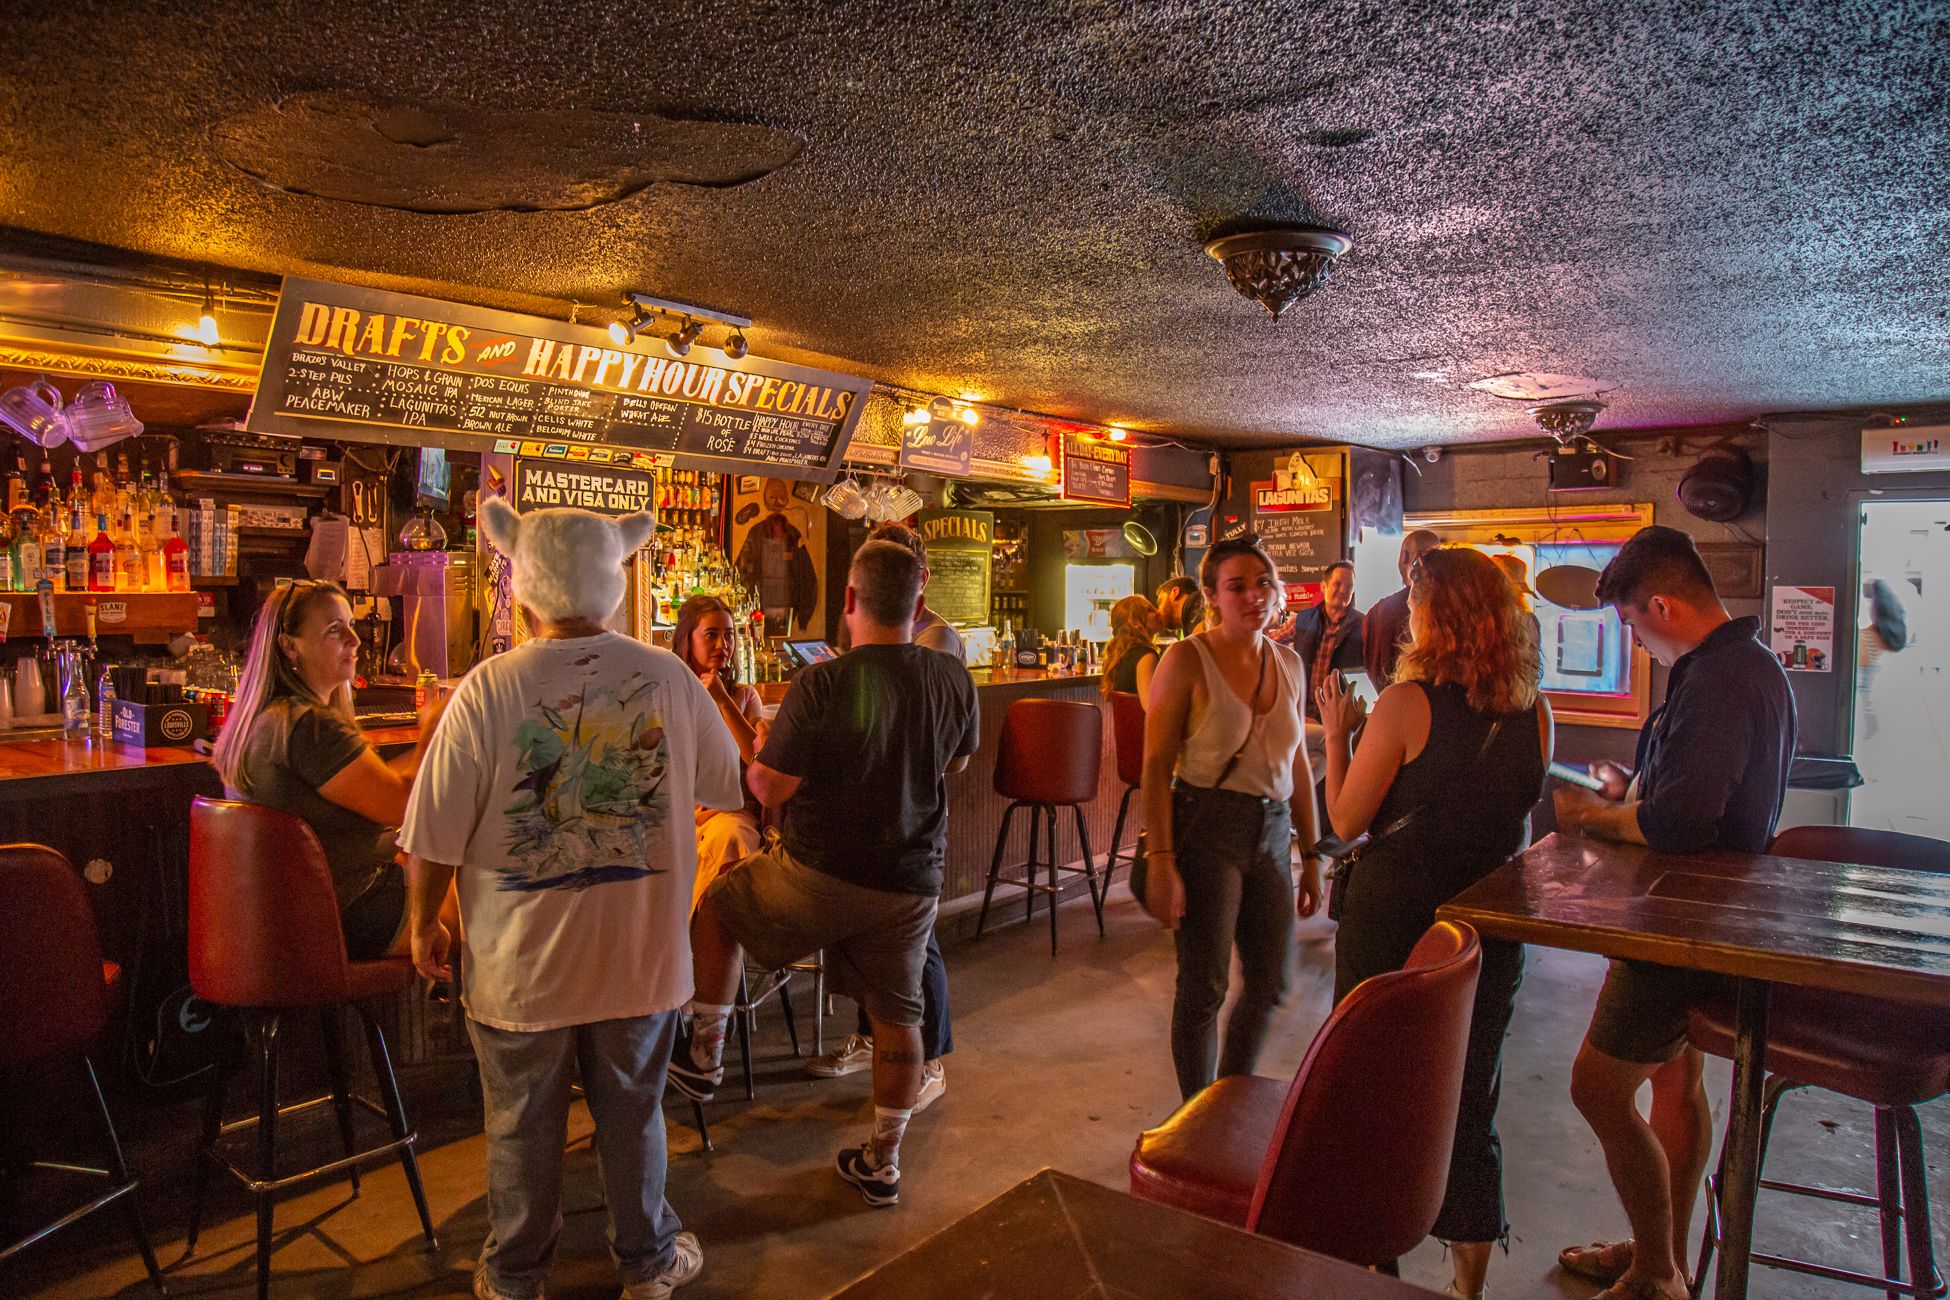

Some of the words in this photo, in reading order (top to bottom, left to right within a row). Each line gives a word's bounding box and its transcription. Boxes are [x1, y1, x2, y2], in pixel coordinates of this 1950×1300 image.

[292, 352, 327, 365] BRAZOS
[331, 358, 366, 373] VALLEY
[293, 301, 472, 366] DRAFTS
[476, 341, 517, 362] AND
[522, 337, 645, 390] HAPPY
[637, 356, 727, 407] HOUR
[723, 371, 852, 420] SPECIALS
[288, 368, 326, 382] 2-STEP
[330, 372, 353, 385] PILS
[388, 365, 420, 380] HOPS
[434, 372, 463, 388] GRAIN
[382, 379, 438, 396] MOSAIC
[444, 385, 458, 399] IPA
[474, 376, 495, 389] DOS
[499, 380, 530, 395] EQUIS
[548, 386, 591, 399] PINTHOUSE
[311, 387, 345, 402] ABW
[471, 393, 503, 404] MEXICAN
[507, 396, 534, 408] LAGER
[286, 395, 371, 418] PEACEMAKER
[390, 397, 457, 417] LAGUNITAS
[544, 397, 570, 406] BLIND
[572, 399, 592, 408] JAKE
[548, 404, 580, 413] PORTER
[402, 411, 426, 426] IPA
[469, 406, 486, 418] 512
[489, 411, 505, 421] NUT
[620, 410, 650, 420] WHEAT
[695, 407, 714, 425] $15
[713, 413, 753, 431] BOTTLE
[463, 419, 492, 431] BROWN
[495, 424, 513, 433] ALE
[537, 414, 565, 425] CELIS
[567, 419, 595, 429] WHITE
[757, 415, 779, 428] HAPPY
[780, 419, 800, 431] HOUR
[802, 421, 819, 429] EVERY
[572, 431, 597, 441] WHITE
[721, 428, 732, 438] OF
[749, 432, 758, 440] $3
[758, 434, 773, 442] WELL
[775, 436, 801, 445] COCKTAILS
[743, 446, 752, 454] $4
[525, 469, 649, 496] MASTERCARD
[521, 486, 561, 504] AND
[563, 490, 606, 509] VISA
[608, 494, 650, 511] ONLY
[1259, 489, 1329, 506] LAGUNITAS
[924, 516, 988, 543] SPECIALS
[1267, 518, 1289, 529] IRISH
[1292, 516, 1311, 526] MULE
[1289, 542, 1310, 550] NEVADA
[100, 603, 125, 611] SLANE
[115, 715, 140, 734] FORESTER
